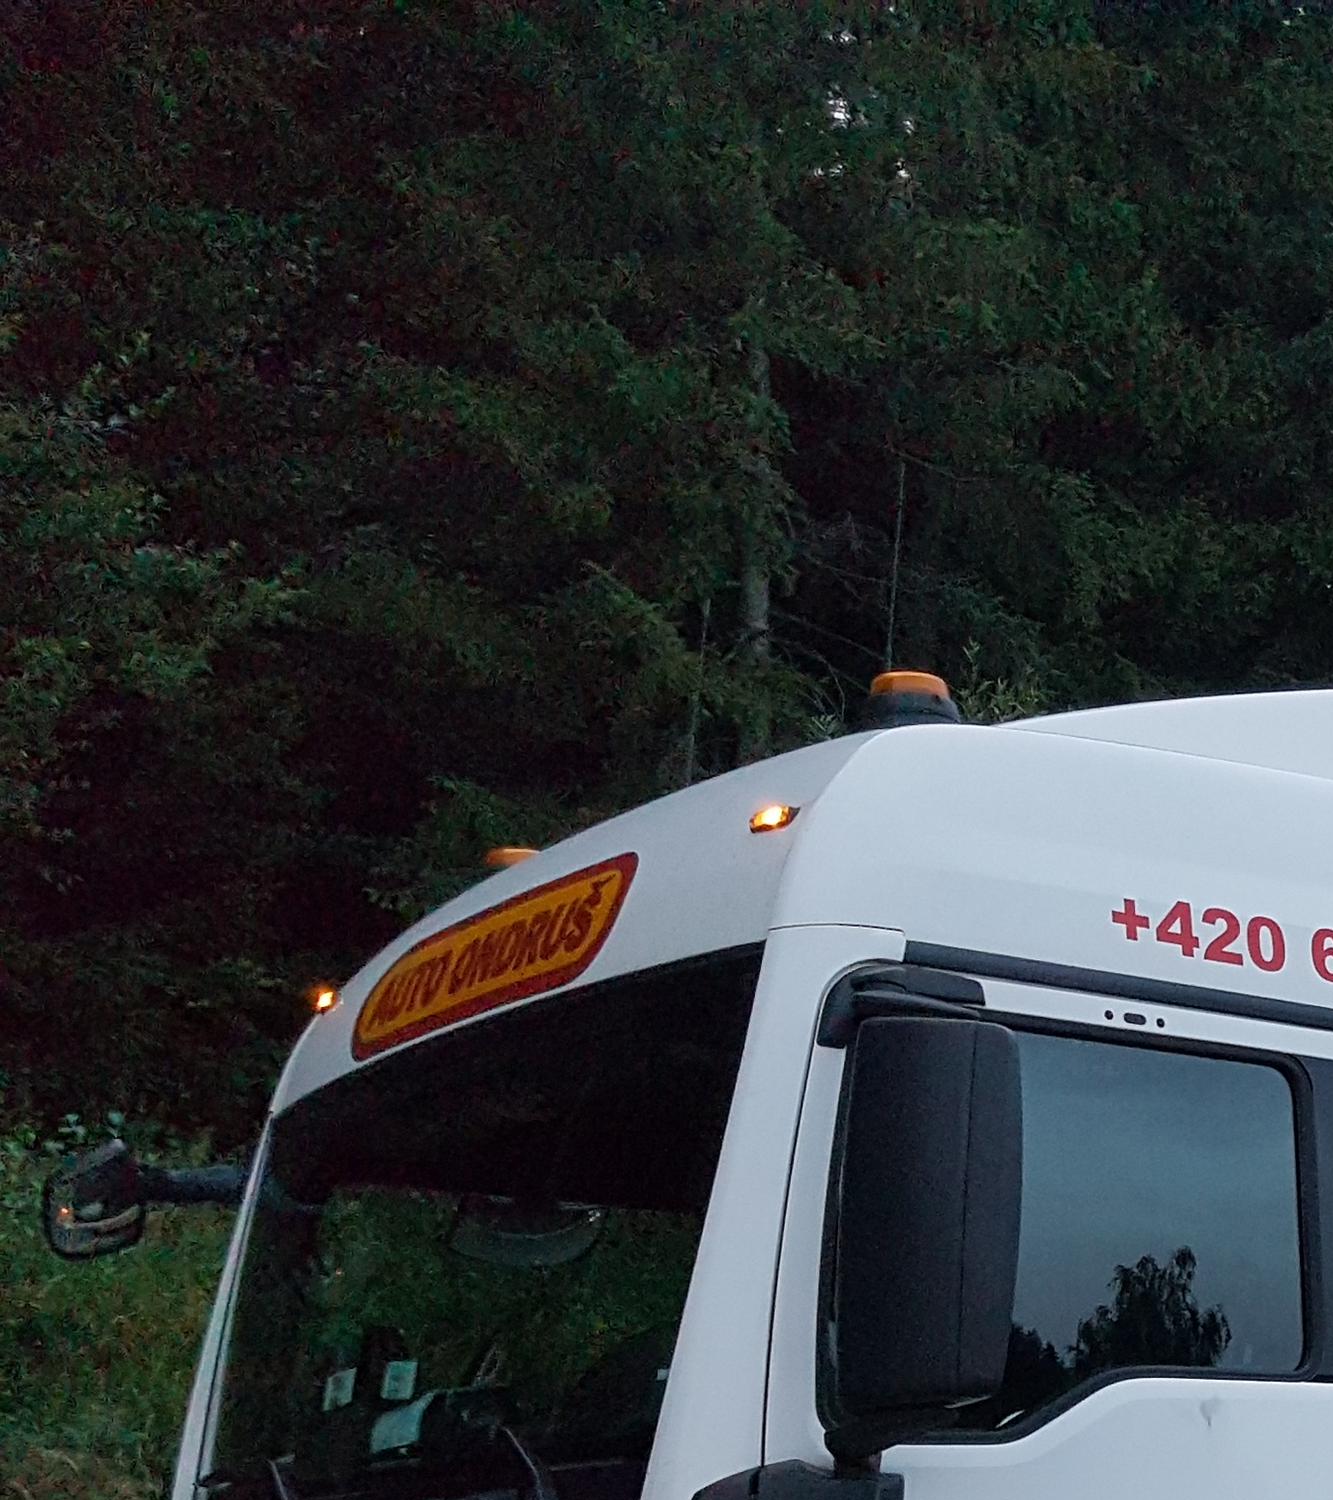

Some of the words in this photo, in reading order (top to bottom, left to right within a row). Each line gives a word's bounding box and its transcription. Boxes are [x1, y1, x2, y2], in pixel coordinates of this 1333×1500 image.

[368, 949, 453, 1030] AUTO
[448, 873, 616, 995] ONDRUŠ
[1111, 898, 1285, 971] +420
